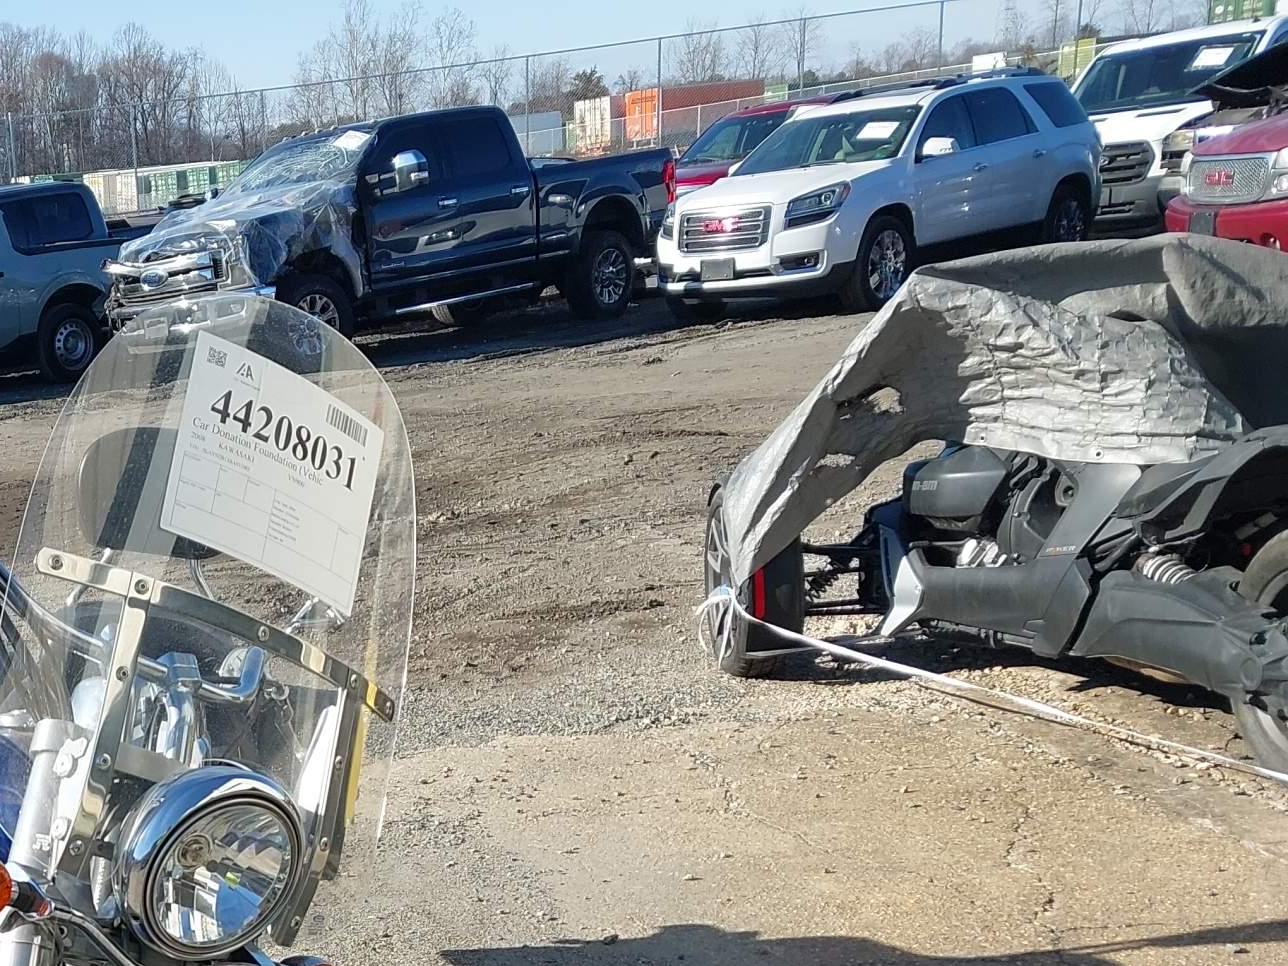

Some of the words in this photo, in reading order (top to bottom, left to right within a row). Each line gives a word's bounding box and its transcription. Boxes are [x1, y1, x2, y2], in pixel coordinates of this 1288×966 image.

[192, 416, 209, 431] Car
[212, 423, 252, 450] Donation
[253, 441, 297, 473] Foundation
[298, 464, 324, 486] (Vehic
[210, 389, 356, 491] 44208031
[218, 442, 255, 463] KAWASAKI
